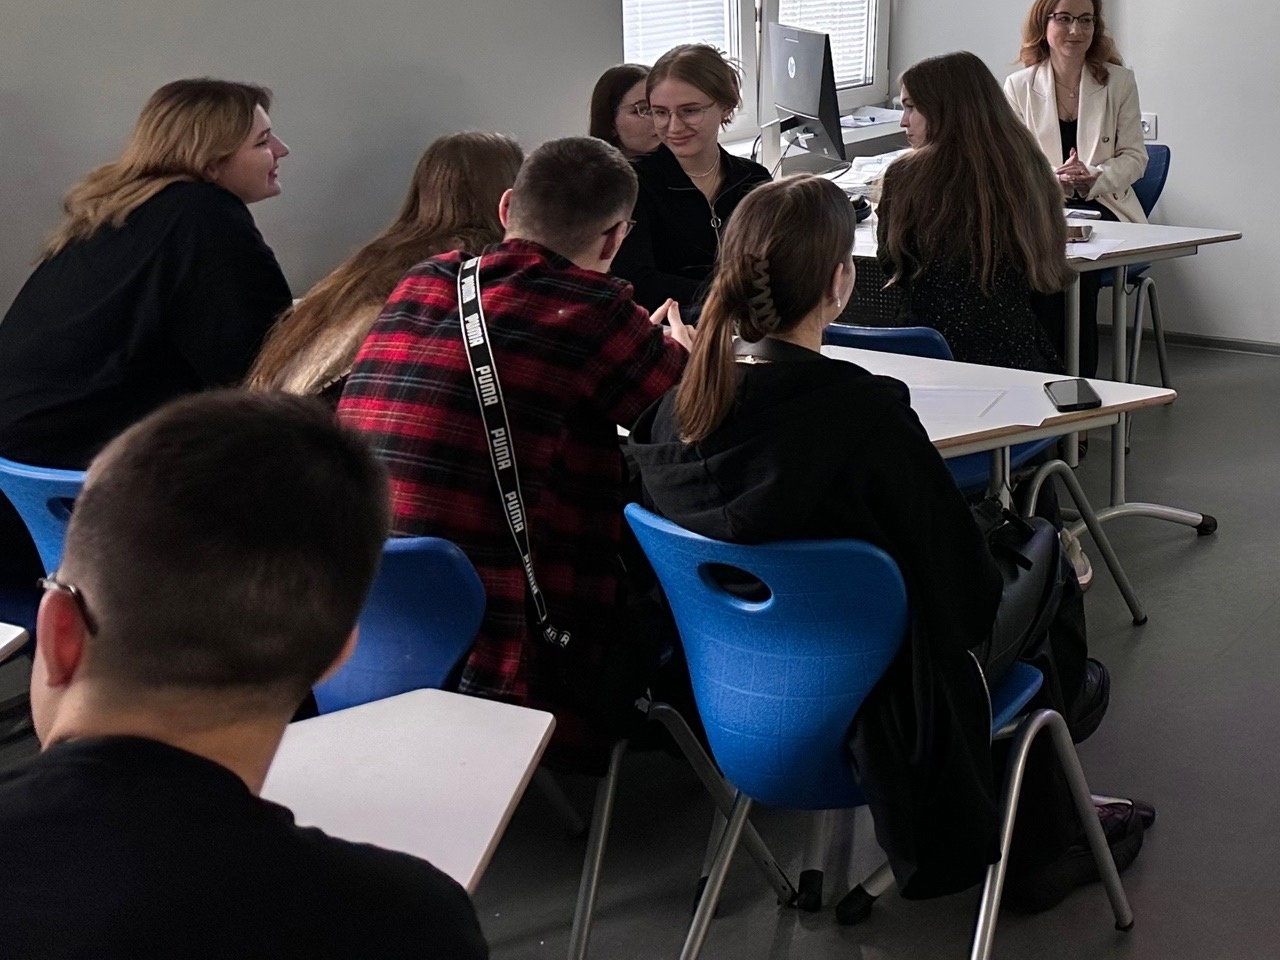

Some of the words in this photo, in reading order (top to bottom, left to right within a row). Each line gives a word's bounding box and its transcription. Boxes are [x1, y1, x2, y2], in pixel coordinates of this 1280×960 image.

[464, 312, 484, 347] PUMA
[476, 365, 498, 406] PUMA
[491, 428, 511, 470] PUMA
[505, 491, 524, 533] PUMA
